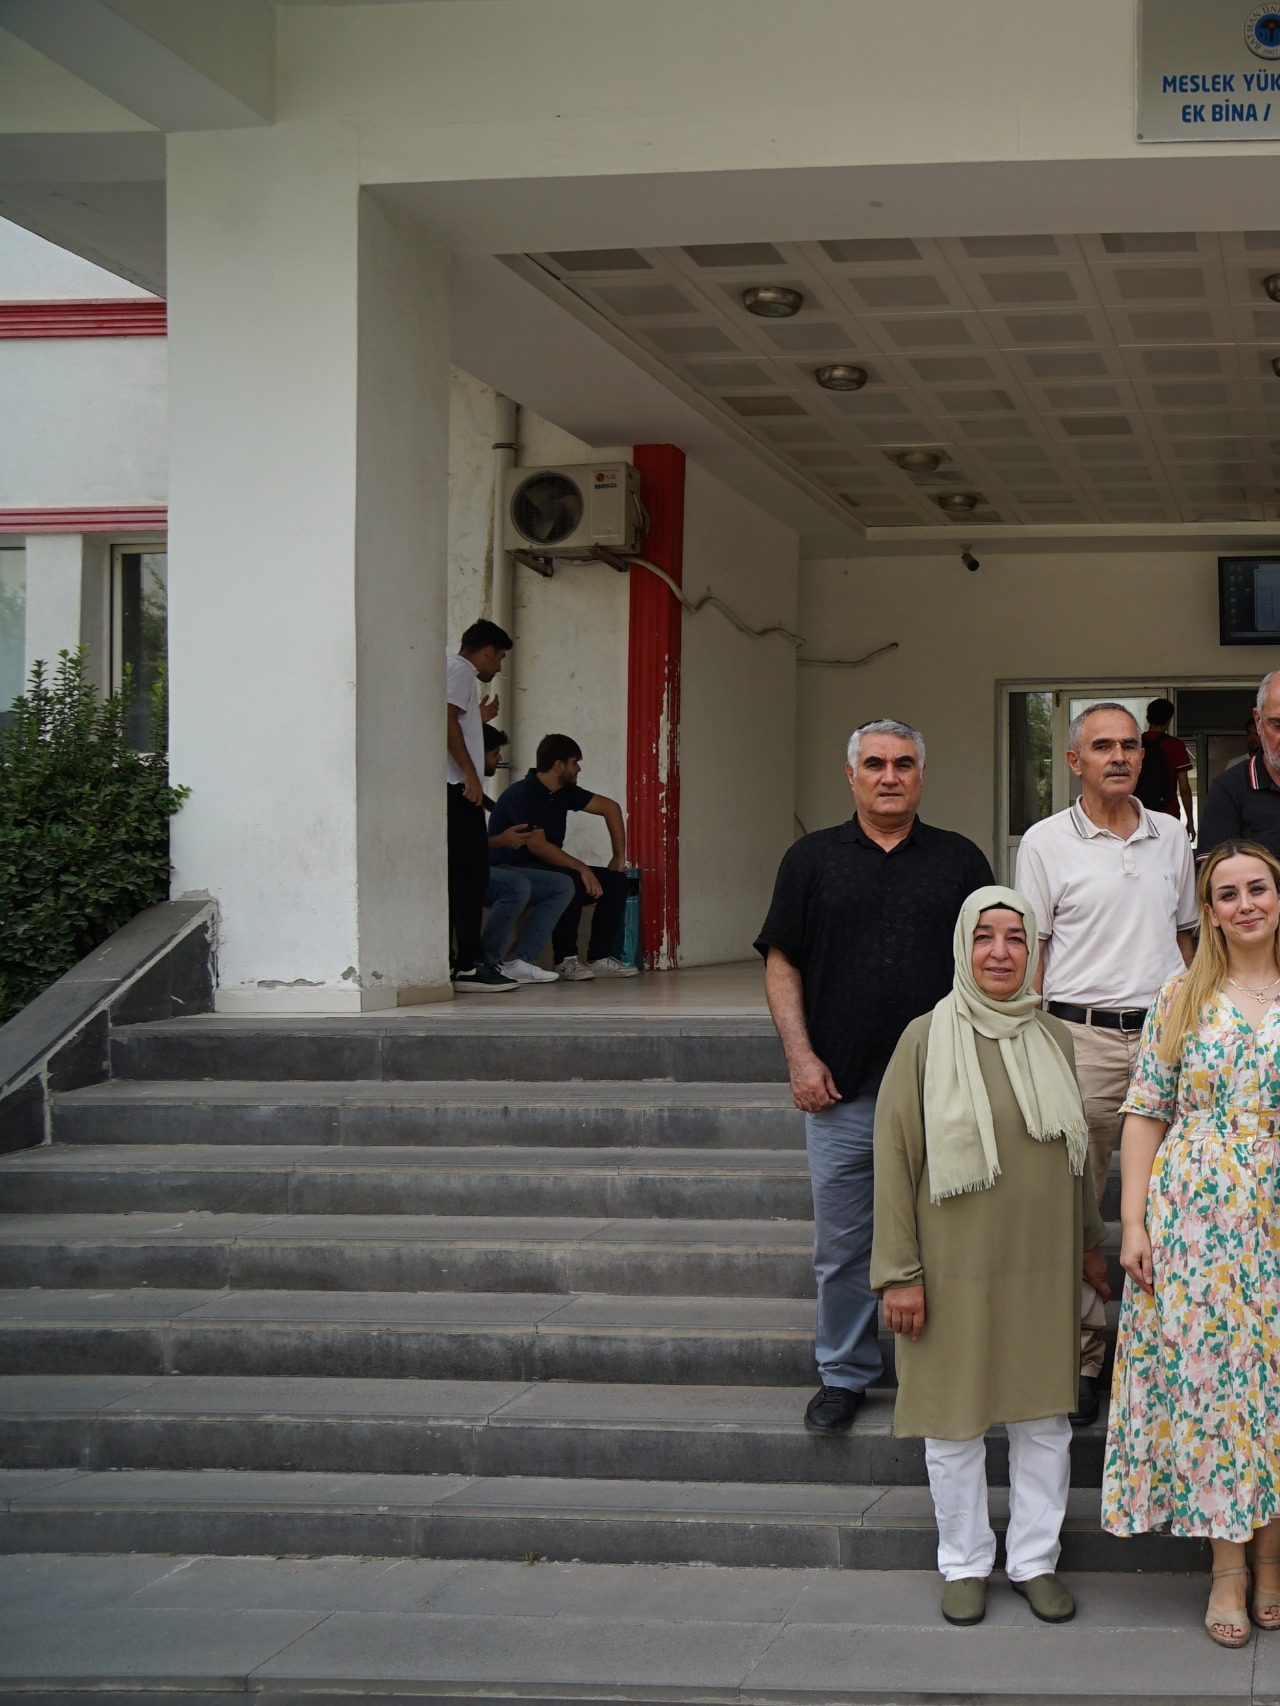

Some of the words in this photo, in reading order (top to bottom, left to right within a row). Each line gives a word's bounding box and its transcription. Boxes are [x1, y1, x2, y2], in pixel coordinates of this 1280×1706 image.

[1246, 10, 1262, 51] BATMAN
[1162, 74, 1235, 93] MESLEK
[1182, 104, 1206, 123] EK
[1211, 99, 1258, 122] BİNA
